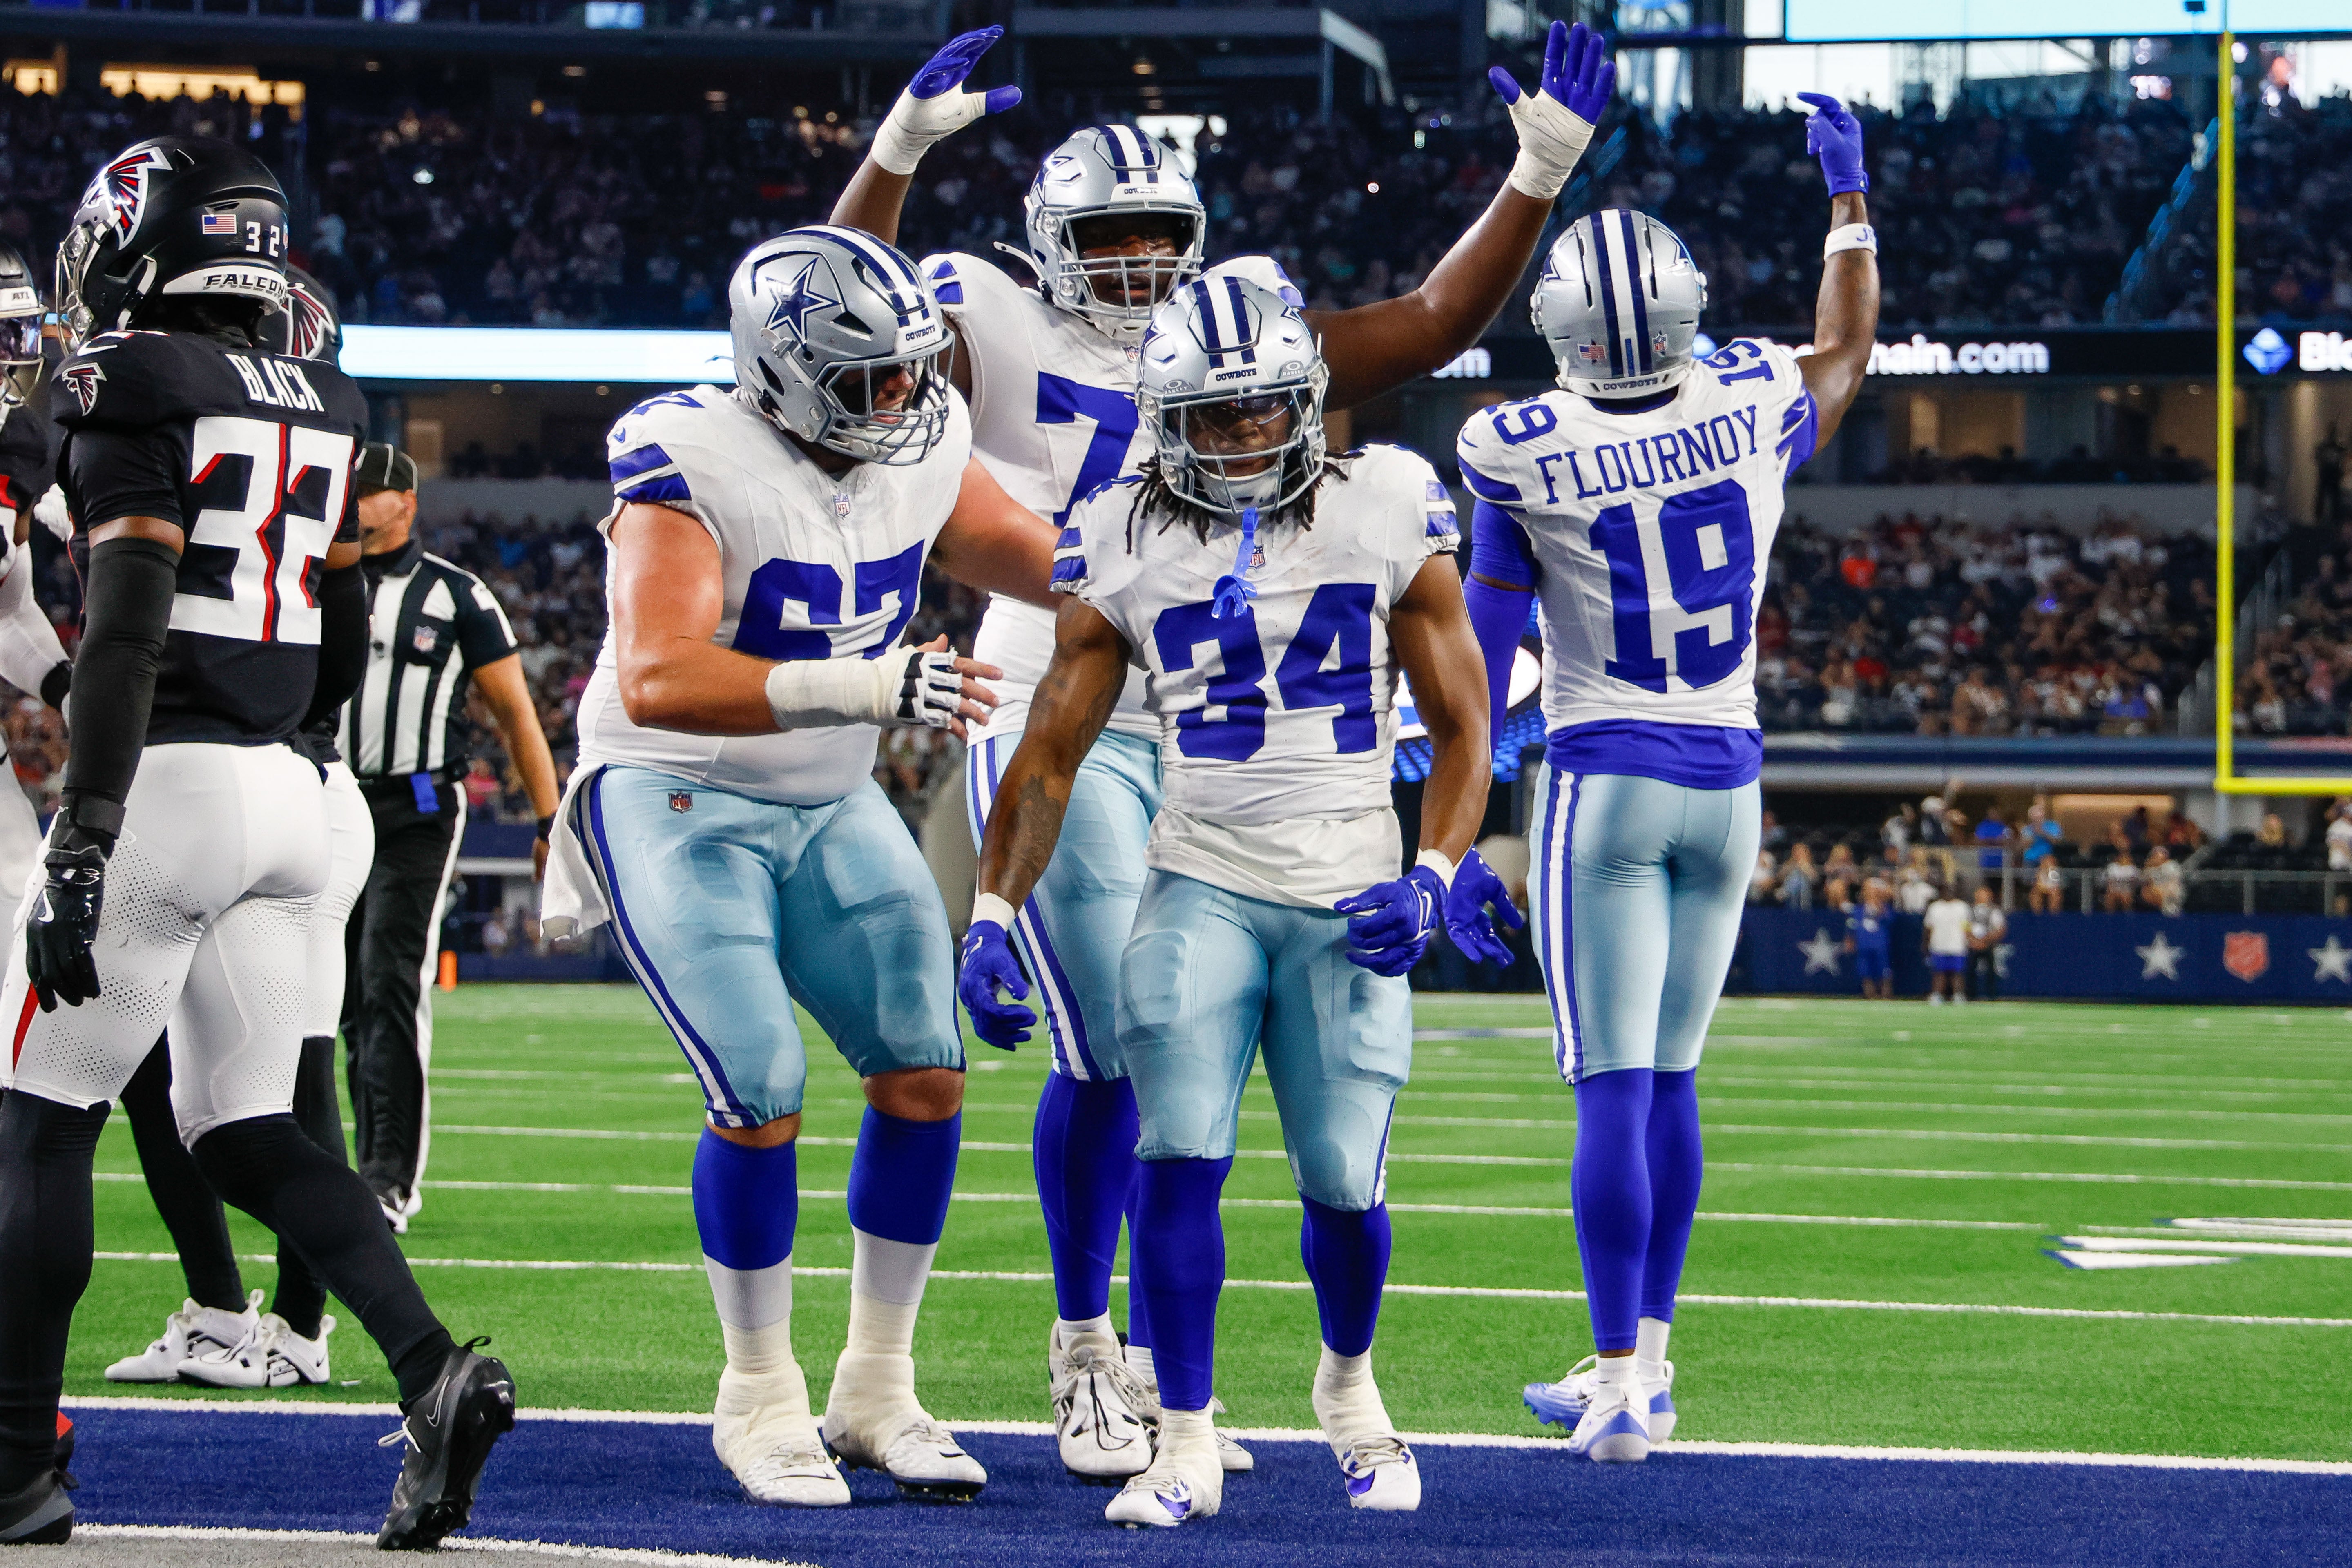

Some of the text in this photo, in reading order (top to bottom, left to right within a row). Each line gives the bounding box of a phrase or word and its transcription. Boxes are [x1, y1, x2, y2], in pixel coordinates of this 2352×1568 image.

[246, 221, 280, 257] 32
[13, 292, 30, 300] ATL
[203, 274, 286, 296] FALCON
[906, 324, 935, 341] COWBOYS
[225, 353, 325, 412] BLACK
[1164, 386, 1187, 394] OAKLEY
[1216, 368, 1257, 382] COWBOYS
[1035, 371, 1139, 529] 7
[1535, 404, 1757, 505] FLOURNOY
[167, 416, 355, 645] 32
[731, 539, 925, 661] 67
[1588, 478, 1756, 694] 19
[1152, 583, 1377, 762] 34
